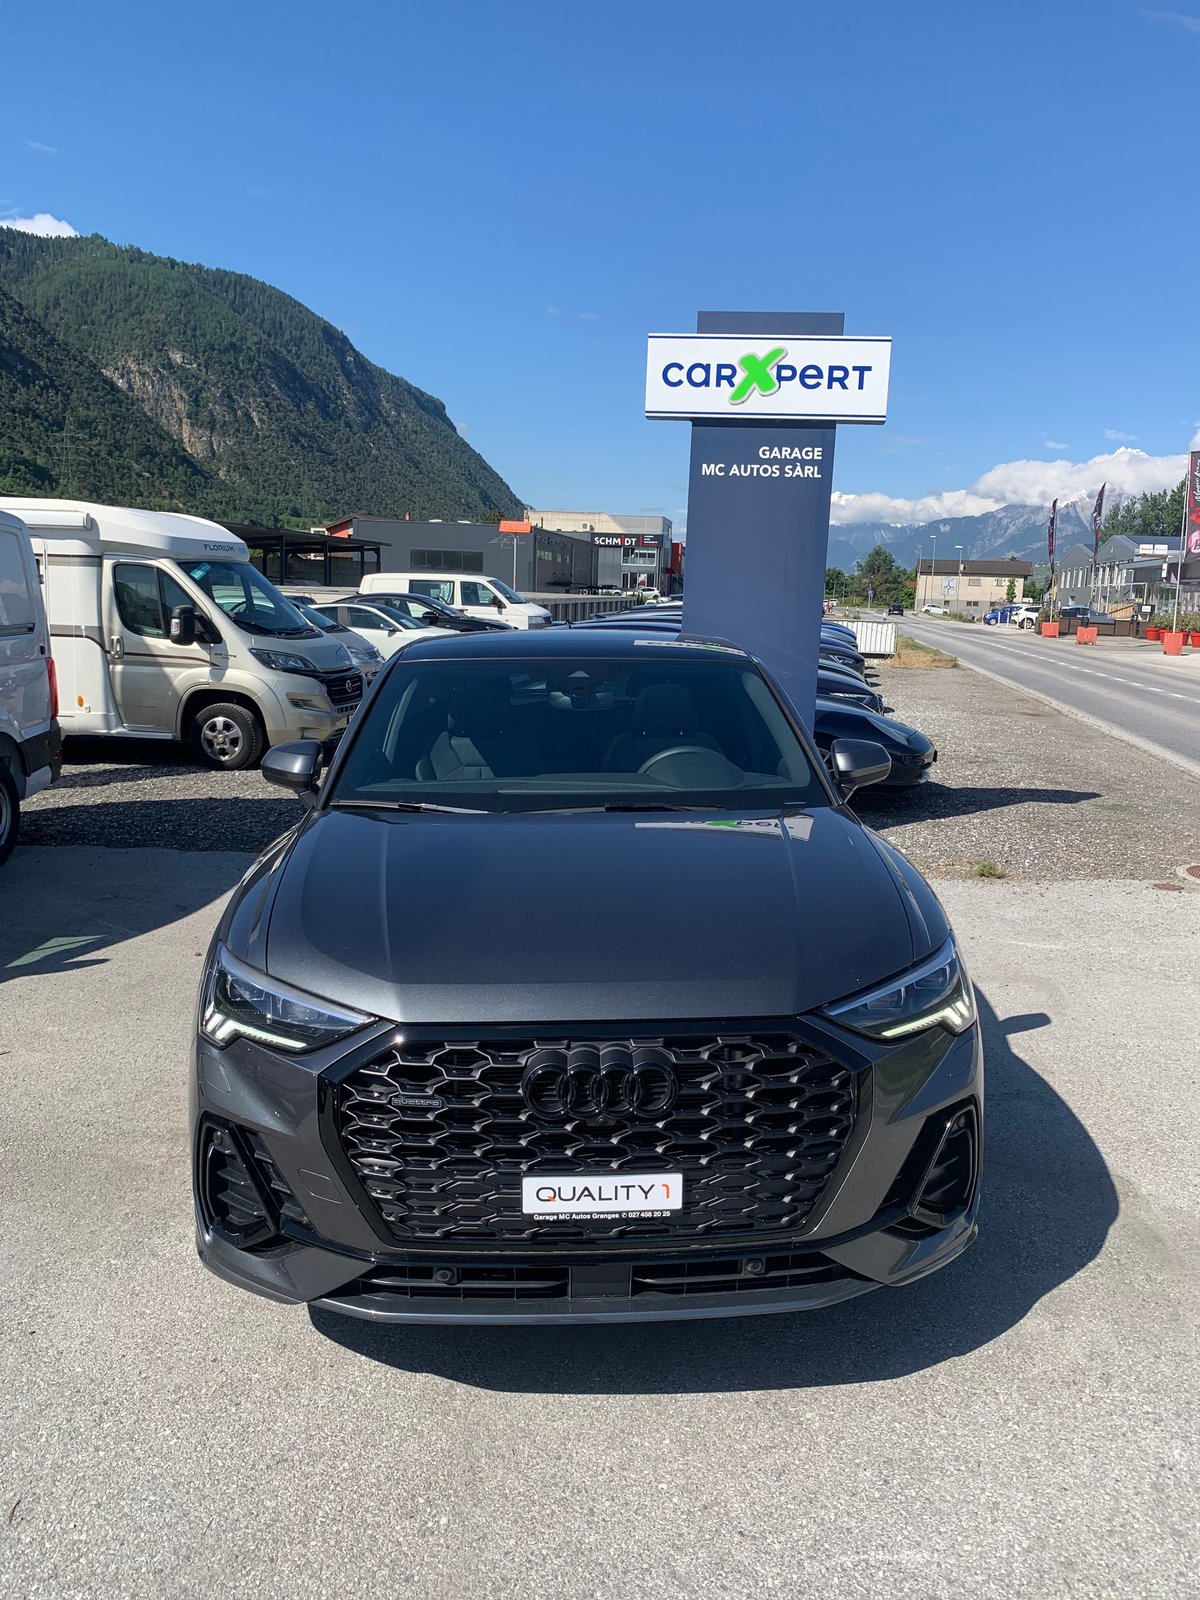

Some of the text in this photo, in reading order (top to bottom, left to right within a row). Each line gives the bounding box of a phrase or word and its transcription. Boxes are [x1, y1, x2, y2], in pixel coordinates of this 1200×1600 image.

[758, 446, 823, 460] GARAGE
[701, 463, 726, 476] MC
[728, 463, 781, 478] AUTOS
[536, 1183, 671, 1202] QUALITY 1
[533, 1213, 558, 1221] Garage
[591, 1211, 620, 1220] Granges
